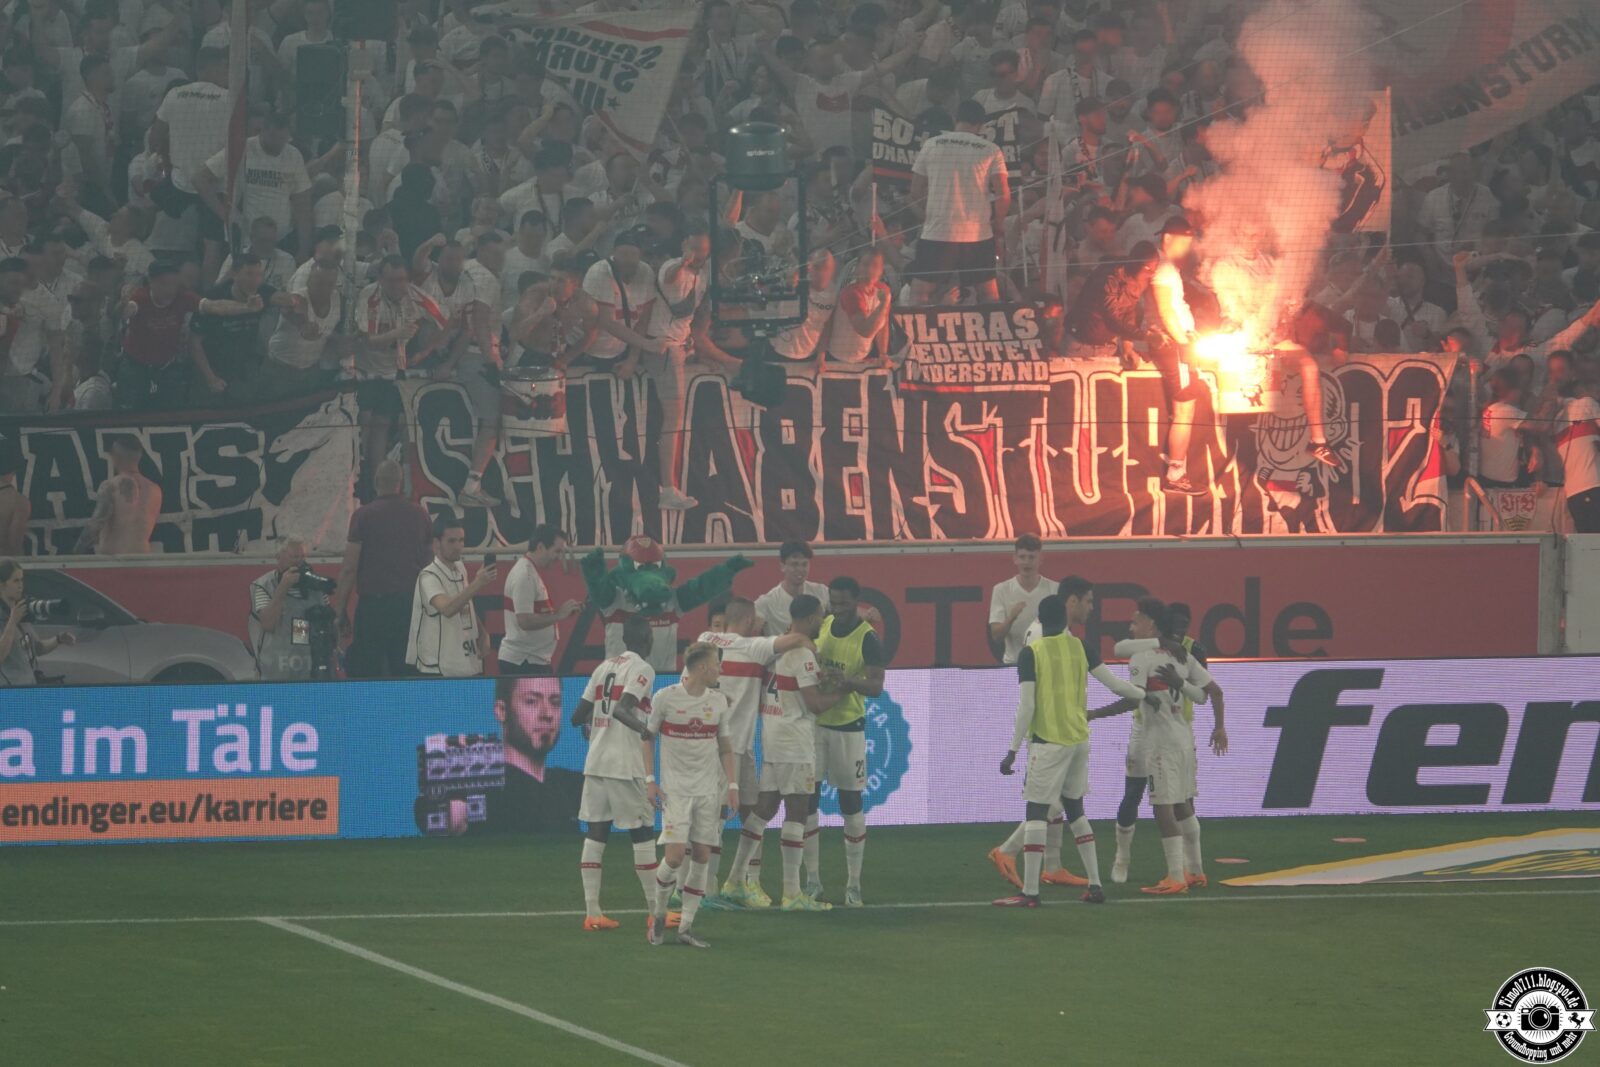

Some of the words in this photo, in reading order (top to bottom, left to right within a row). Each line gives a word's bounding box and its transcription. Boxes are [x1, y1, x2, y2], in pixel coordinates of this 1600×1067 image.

[602, 672, 616, 715] 9
[61, 710, 149, 775] im
[172, 703, 321, 774] Täle
[3, 792, 328, 833] endinger.eu/karriere
